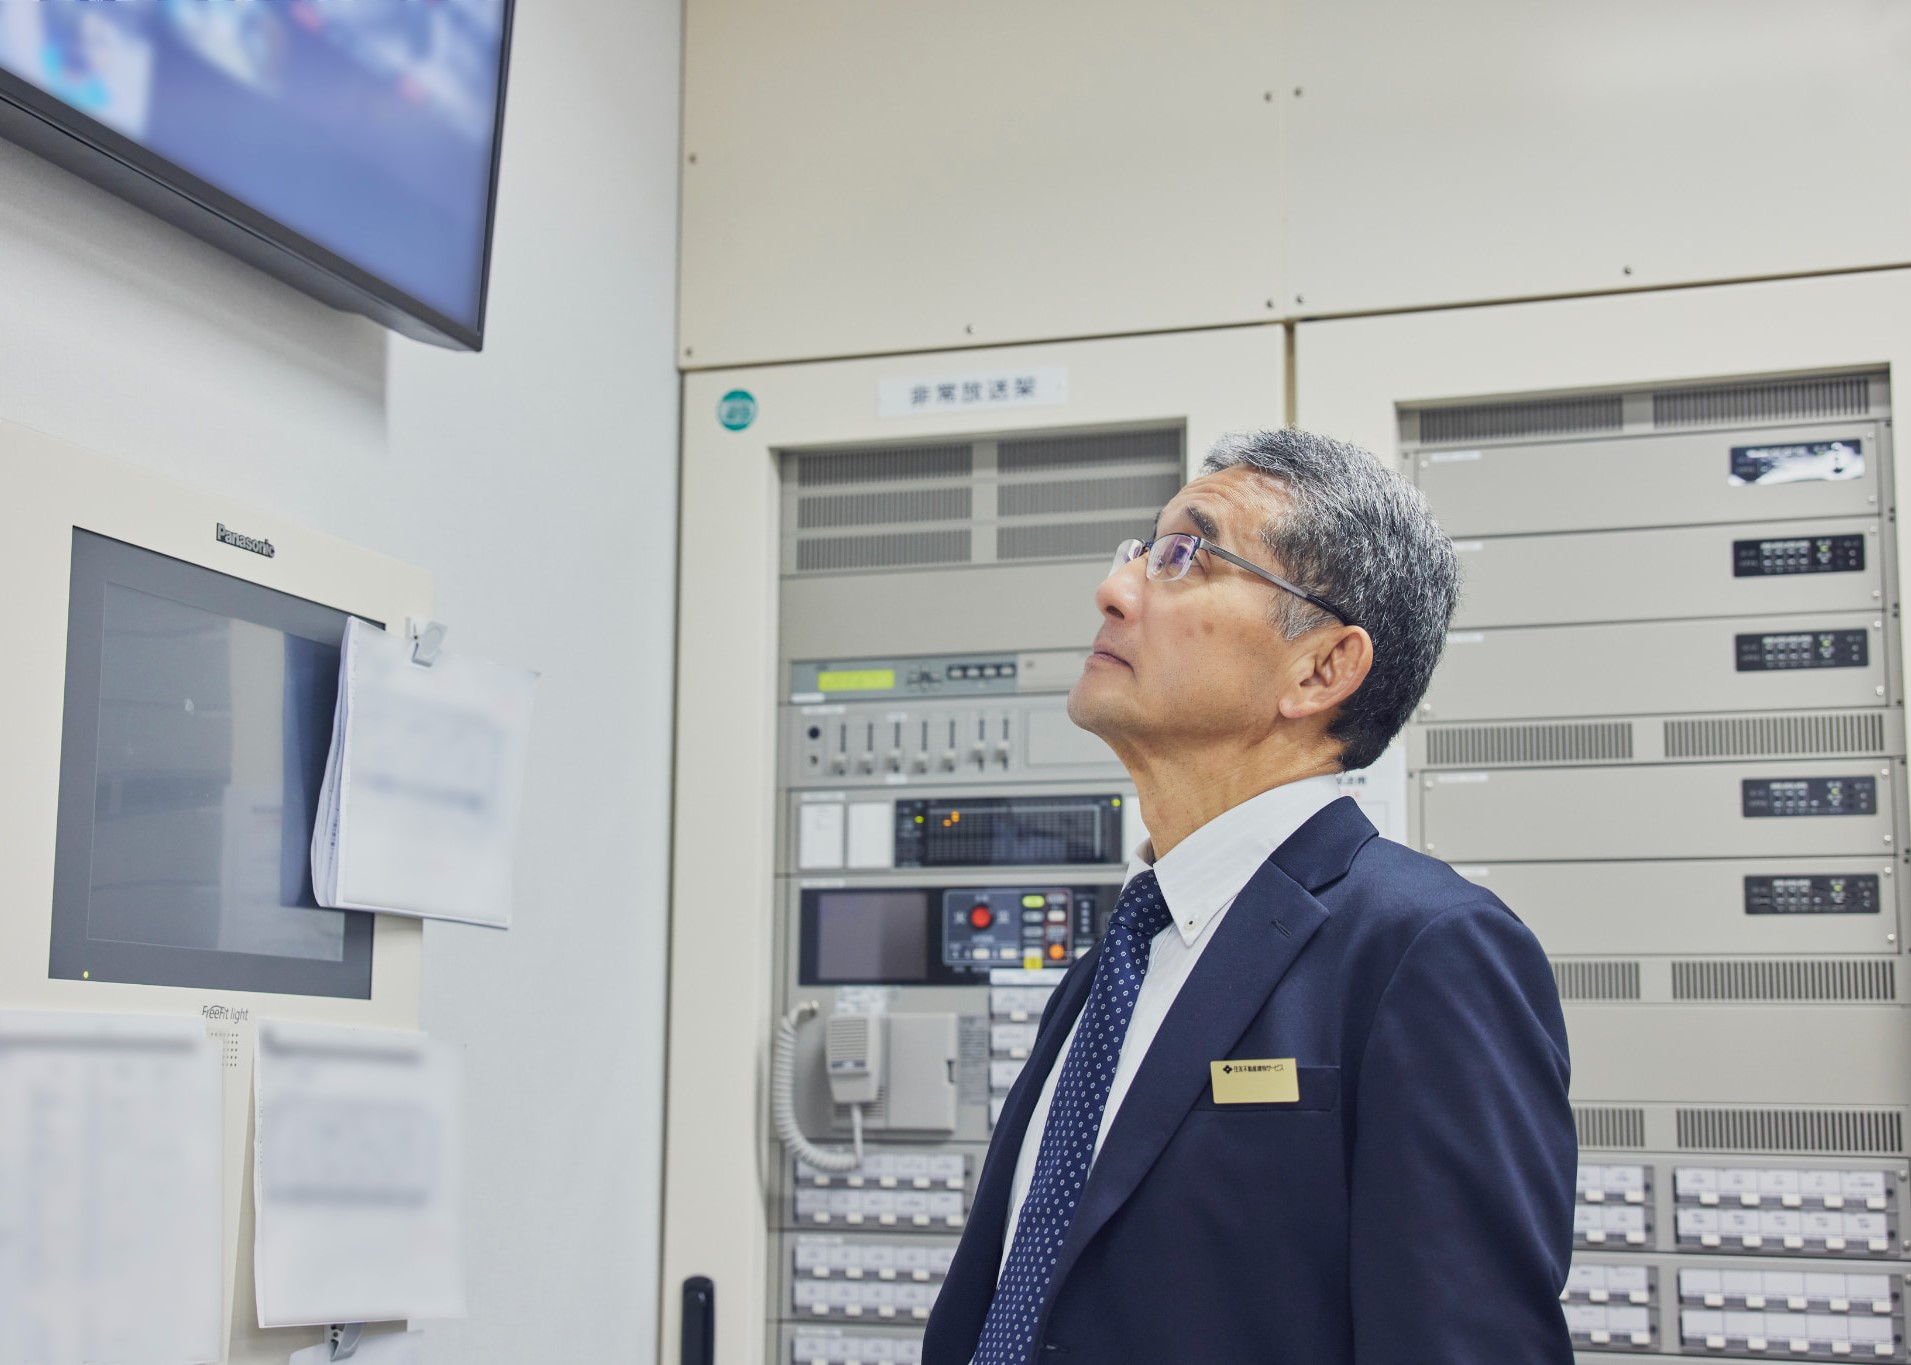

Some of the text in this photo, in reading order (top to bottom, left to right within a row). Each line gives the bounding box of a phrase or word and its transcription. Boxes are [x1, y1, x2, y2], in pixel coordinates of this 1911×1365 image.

[910, 377, 1036, 404] 非常放送架
[216, 522, 275, 558] Panasonic
[230, 1008, 249, 1024] light
